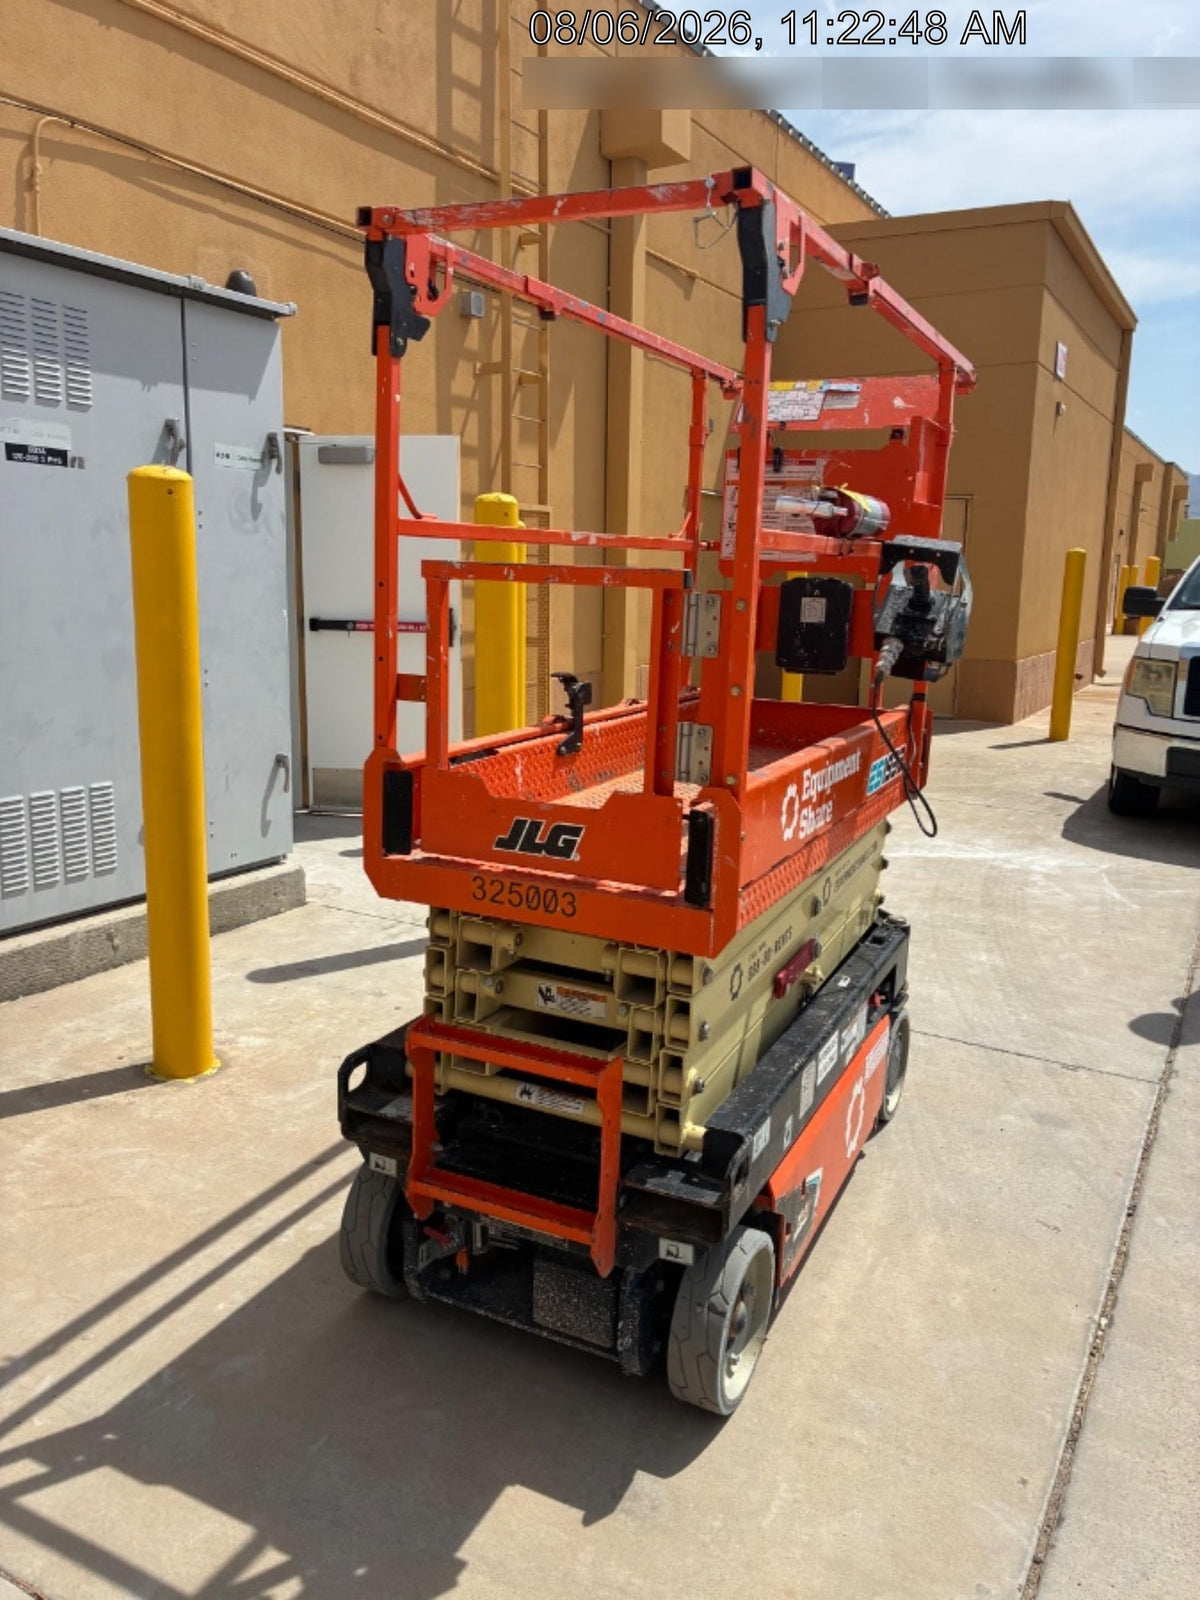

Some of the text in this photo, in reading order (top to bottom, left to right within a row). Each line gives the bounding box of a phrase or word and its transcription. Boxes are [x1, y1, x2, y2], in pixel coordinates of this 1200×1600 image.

[802, 749, 862, 802] Equipment
[493, 816, 585, 861] JLG
[799, 800, 833, 840] Share
[471, 875, 577, 918] 325003
